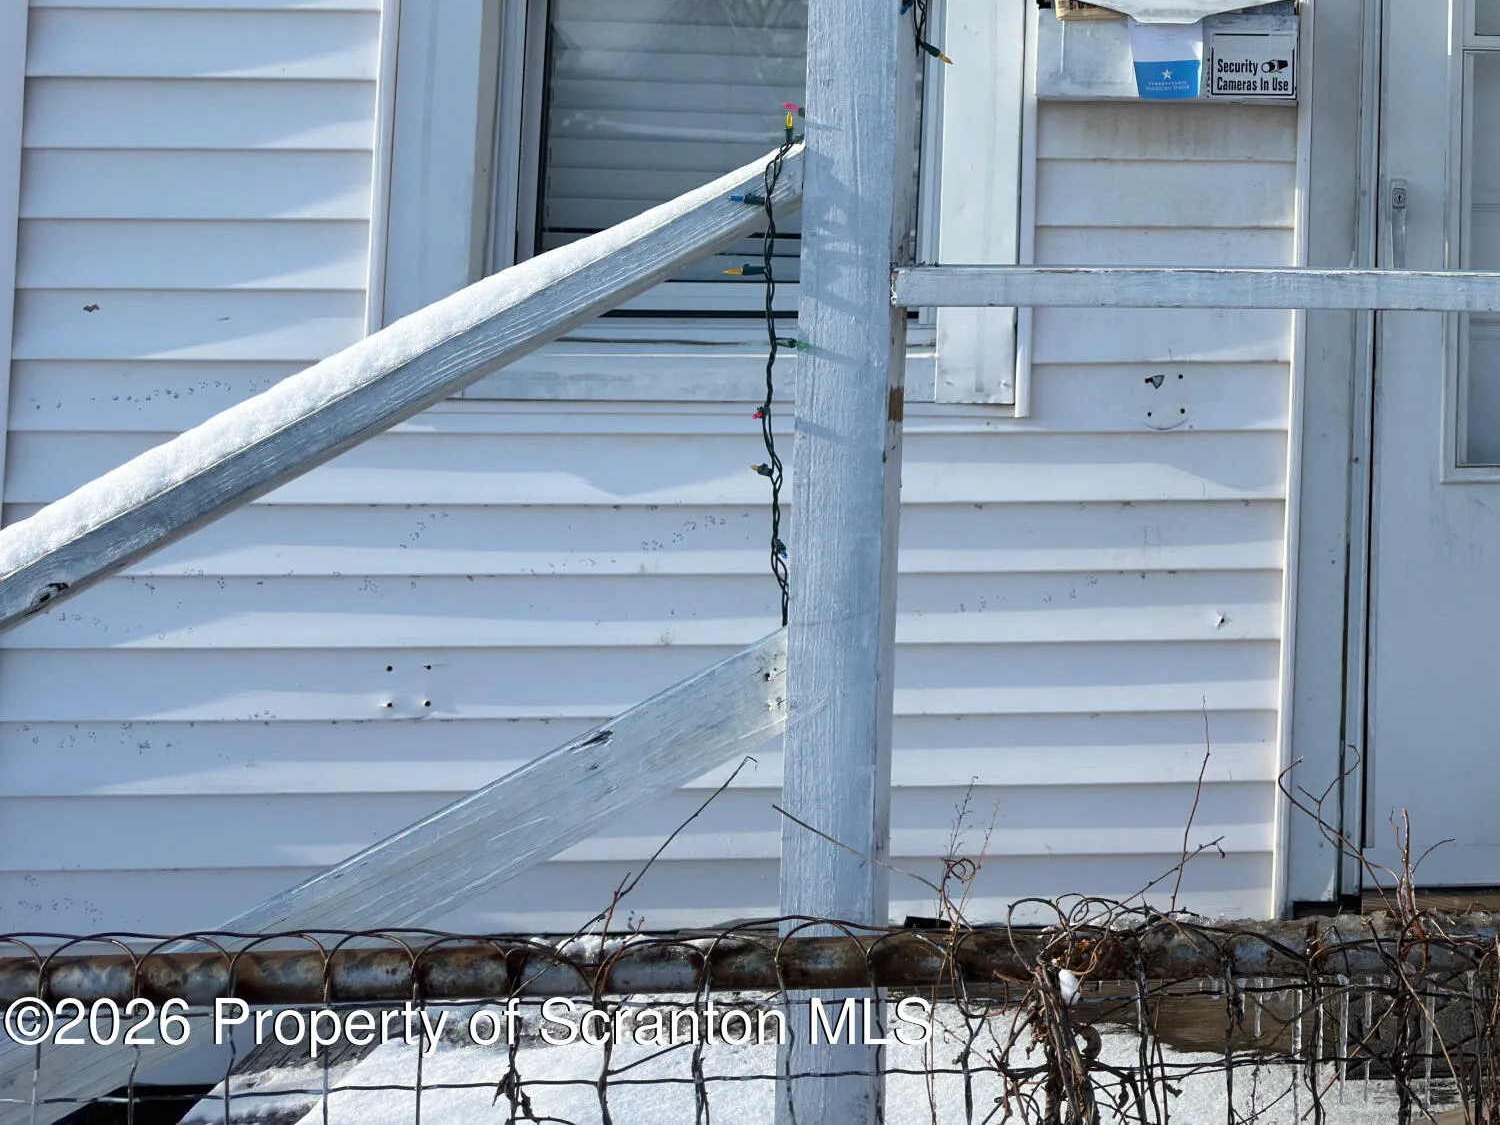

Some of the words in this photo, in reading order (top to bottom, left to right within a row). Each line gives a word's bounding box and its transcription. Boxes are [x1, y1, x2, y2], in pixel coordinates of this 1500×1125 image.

[1217, 58, 1258, 76] Security
[1217, 76, 1257, 91] Cameras
[1260, 76, 1270, 91] In
[1272, 76, 1289, 91] Use
